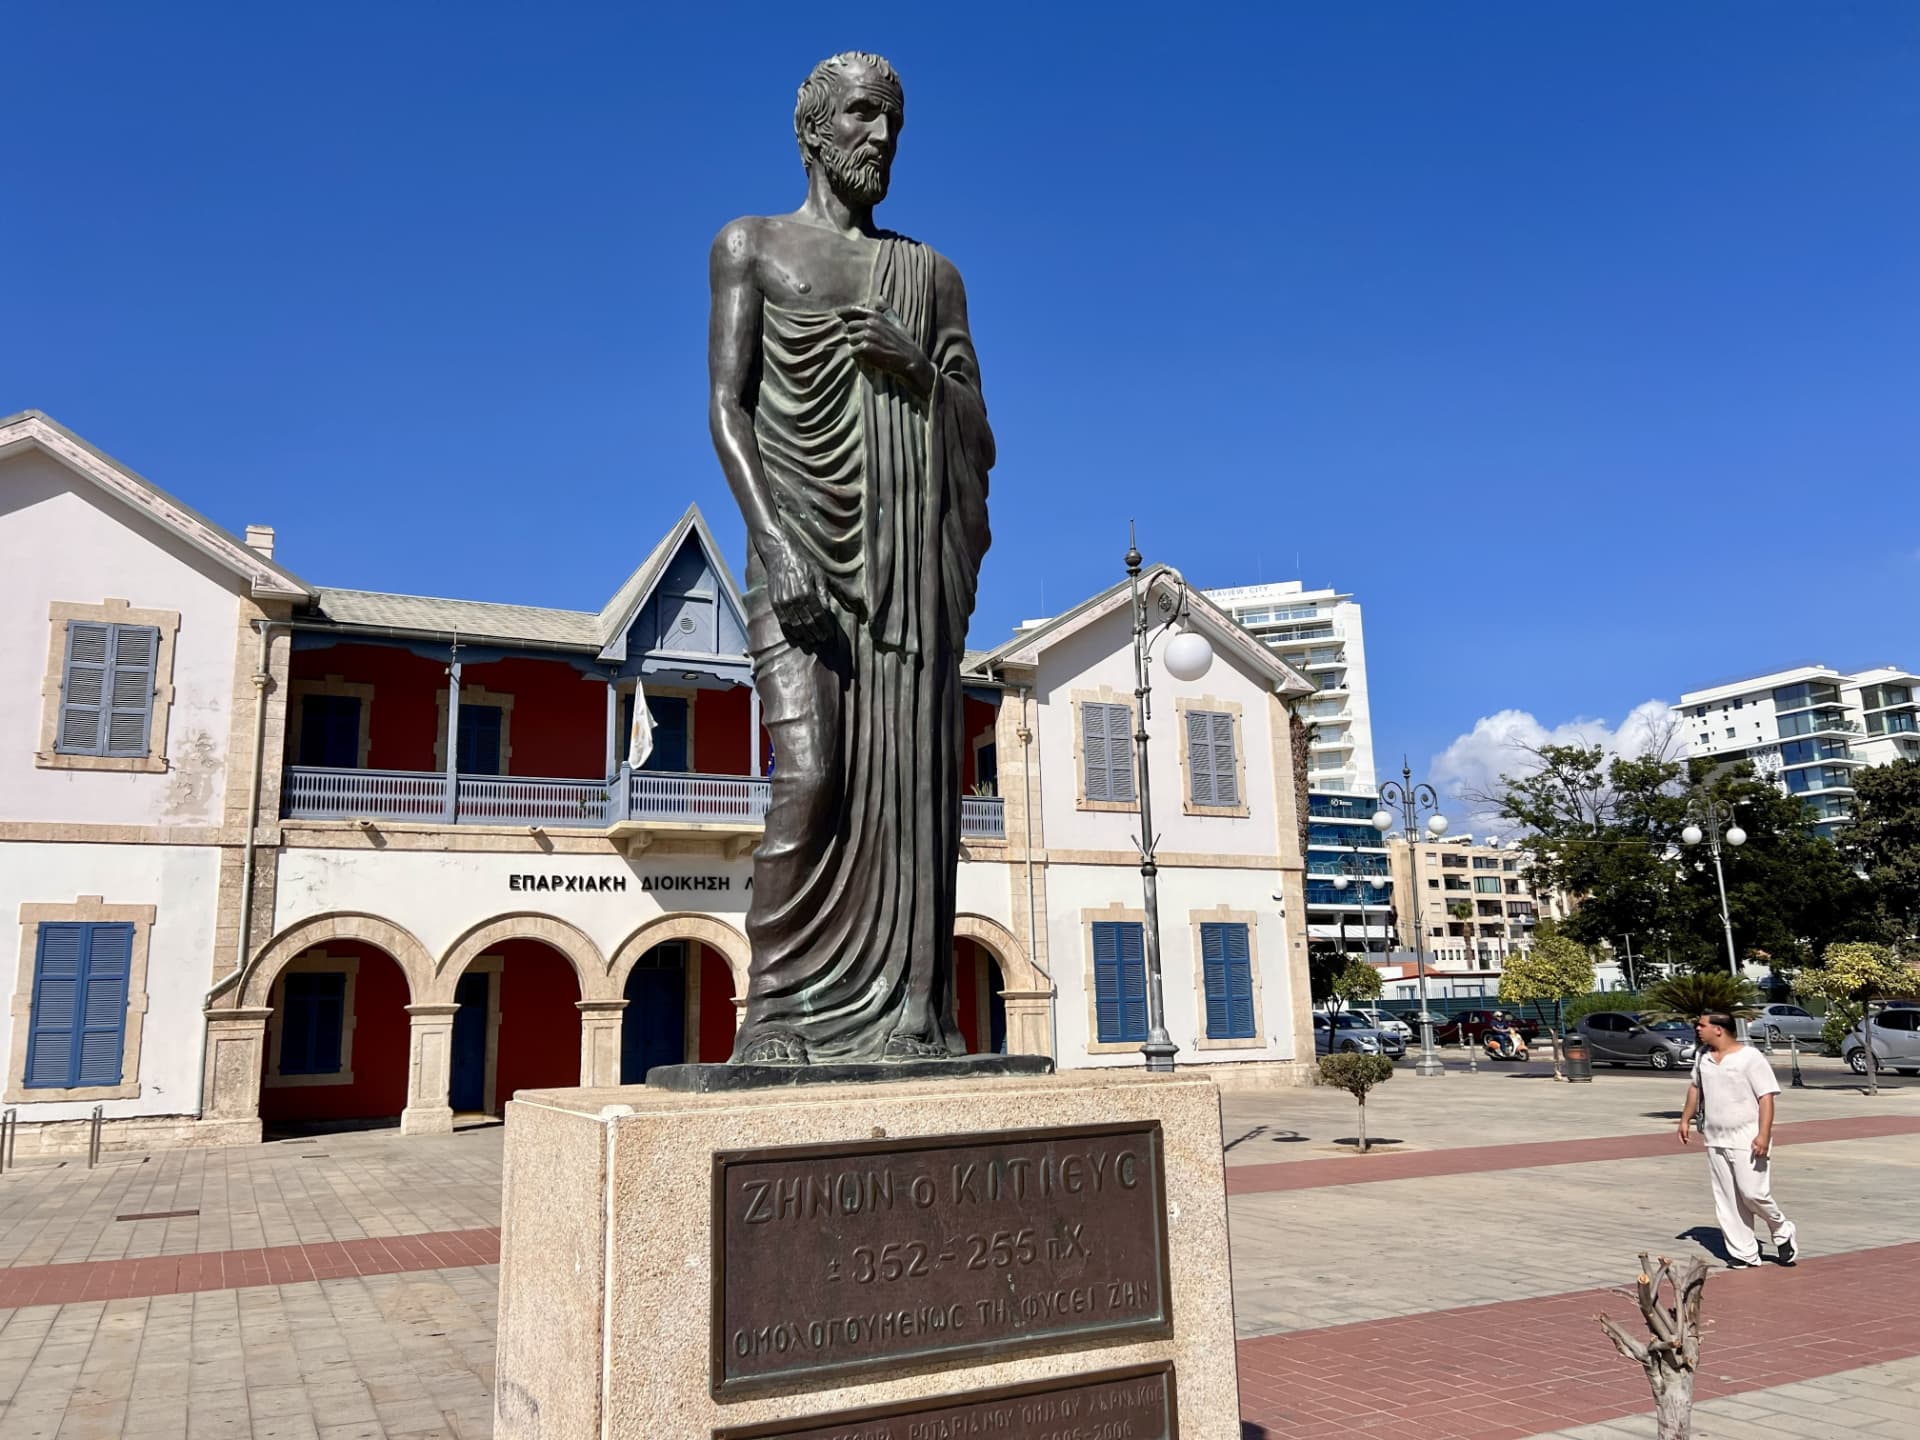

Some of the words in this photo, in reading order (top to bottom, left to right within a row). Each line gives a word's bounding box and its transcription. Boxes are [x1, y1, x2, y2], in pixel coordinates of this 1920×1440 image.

[1249, 586, 1269, 594] CITY
[509, 874, 626, 891] ΕΠΑΡΧΙΑΚΗ
[641, 875, 730, 891] ΔΙΟΙΚΗΣΗ
